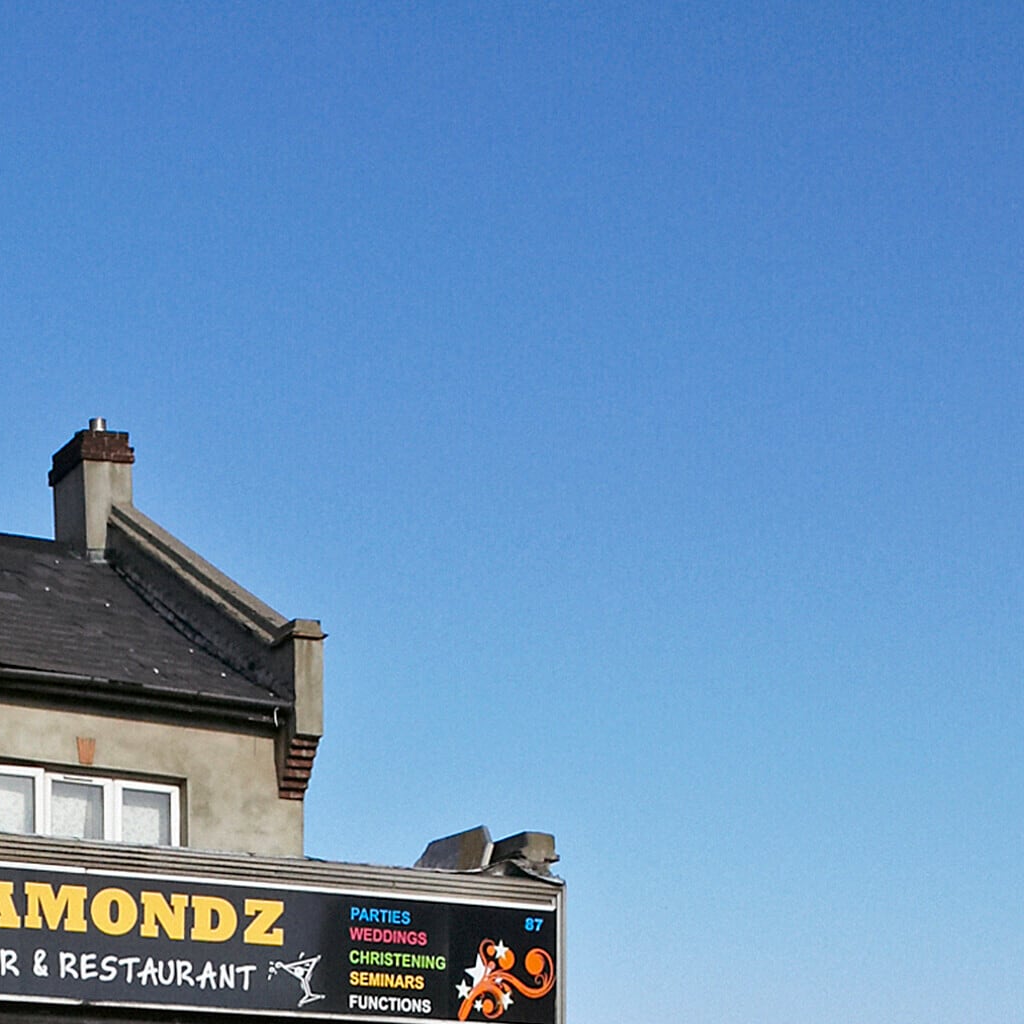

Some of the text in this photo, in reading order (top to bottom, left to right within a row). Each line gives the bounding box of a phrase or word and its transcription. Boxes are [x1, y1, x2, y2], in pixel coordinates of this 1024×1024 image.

[350, 906, 411, 926] PARTIES
[523, 915, 543, 933] 87
[349, 927, 428, 947] WEDDINGS
[348, 950, 447, 971] CHRISTENING
[33, 954, 49, 977] &
[59, 952, 258, 993] RESTAURANT
[349, 971, 425, 990] SEMINARS
[348, 994, 432, 1015] FUNCTIONS
